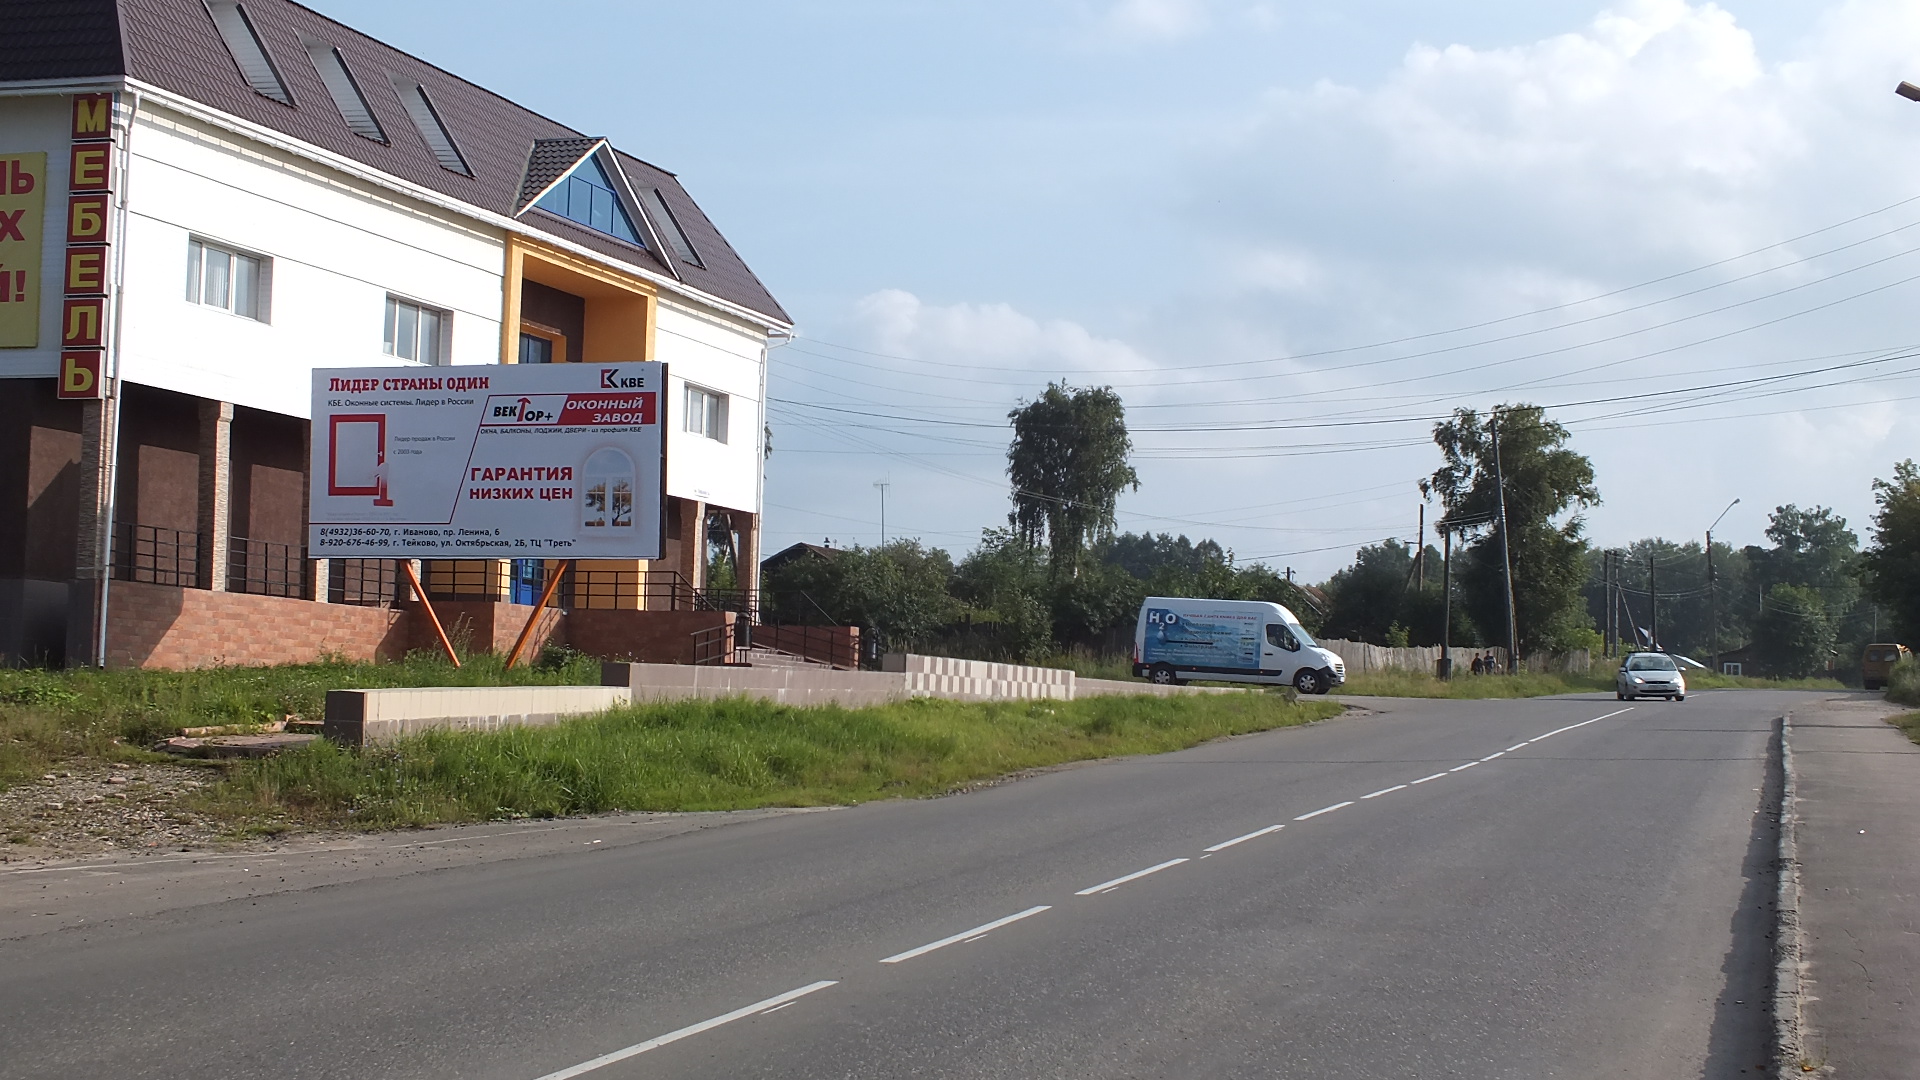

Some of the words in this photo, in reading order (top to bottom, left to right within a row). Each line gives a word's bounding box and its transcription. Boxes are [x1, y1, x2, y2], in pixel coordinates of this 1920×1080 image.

[0, 160, 35, 195] Ь
[63, 98, 107, 393] МЕБЕЛЬ
[383, 377, 443, 391] СТРАНЫ
[446, 377, 489, 392] ОДИН
[415, 398, 440, 408] Лидер
[447, 398, 475, 406] России
[566, 396, 644, 410] ОКОННЫЙ
[592, 412, 644, 424] ЗАВОД
[470, 466, 573, 481] ГАРАНТИЯ
[469, 487, 534, 500] НИЗКИХ
[539, 487, 573, 501] ЦЕН
[403, 528, 441, 537] Иваново,
[443, 529, 456, 537] пр.
[458, 528, 492, 537] Ленина,
[494, 528, 500, 536] 6
[402, 539, 439, 548] Тейково,
[441, 540, 453, 548] ул.
[455, 539, 512, 548] Октябрьская,
[530, 539, 542, 548] ТЦ
